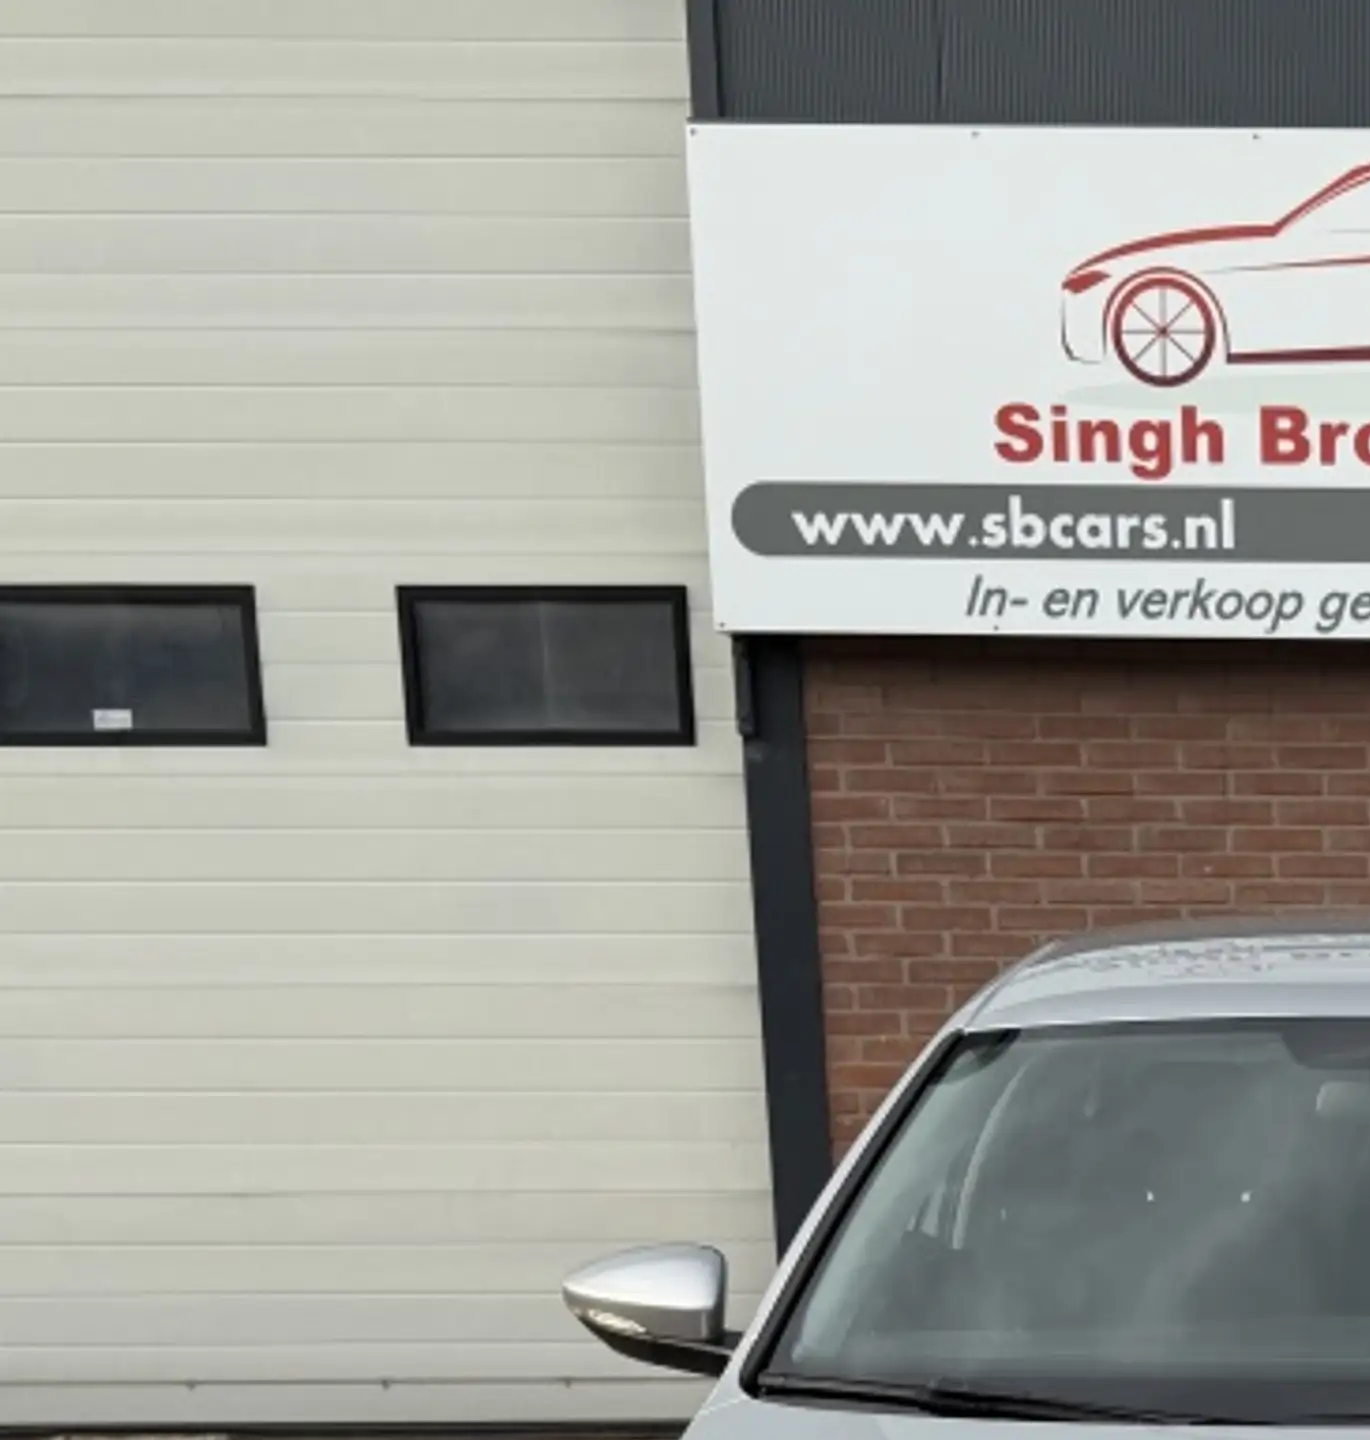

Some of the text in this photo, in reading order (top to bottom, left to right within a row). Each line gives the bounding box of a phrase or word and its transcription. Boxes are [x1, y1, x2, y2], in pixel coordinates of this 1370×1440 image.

[994, 403, 1225, 480] Singh
[791, 496, 1236, 549] www.sbcars.nl
[965, 576, 1029, 617] In-
[1042, 588, 1098, 620] en
[1115, 579, 1304, 632] verkoop
